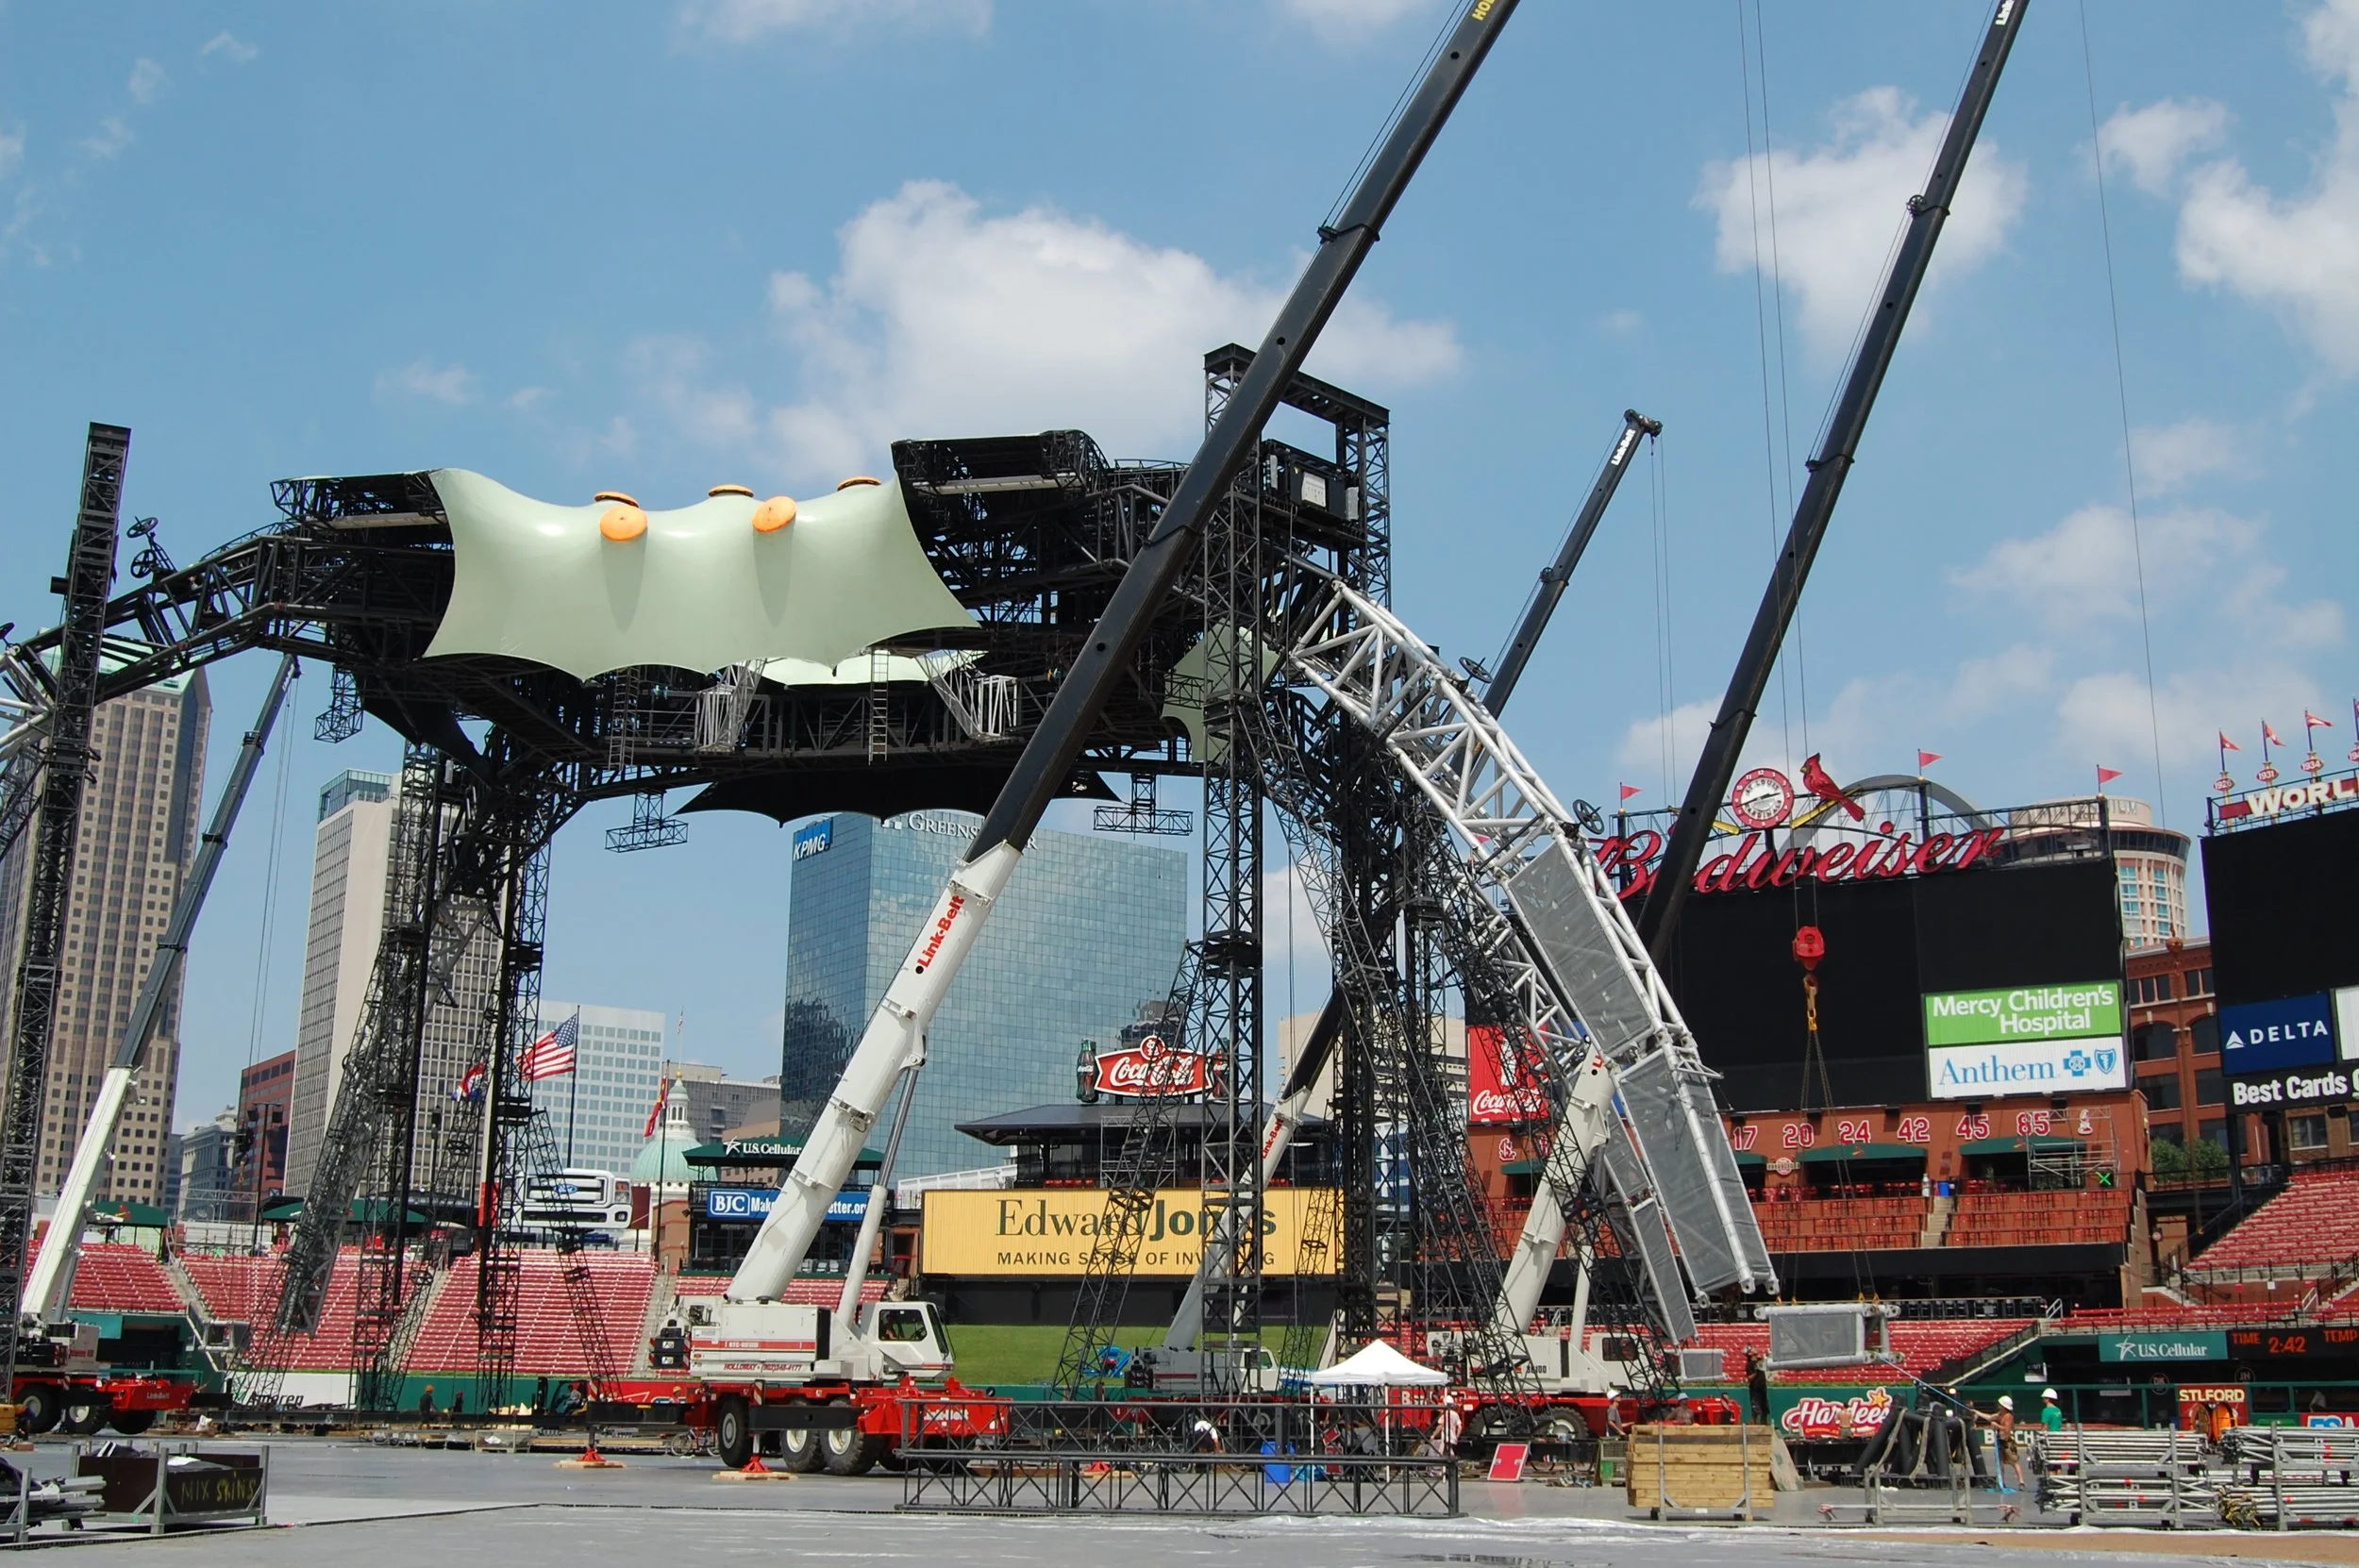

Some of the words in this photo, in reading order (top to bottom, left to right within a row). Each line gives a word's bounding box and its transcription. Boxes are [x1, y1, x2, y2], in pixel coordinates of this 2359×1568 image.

[2258, 769, 2276, 781] 1931
[2302, 759, 2321, 772] 1934
[2247, 774, 2359, 818] WORL
[793, 832, 827, 861] KPMG
[1589, 821, 2004, 900] Bdweiser
[917, 894, 965, 968] Link-Belt
[1932, 995, 2002, 1018] Mercy
[2007, 985, 2115, 1012] Children's
[1999, 1008, 2092, 1036] Hospital
[2250, 1019, 2329, 1044] DELTA
[1939, 1055, 2055, 1085] Anthem
[2233, 1079, 2283, 1106] Best
[2286, 1071, 2349, 1099] Cards
[1782, 1123, 1815, 1149] 20
[1838, 1120, 1872, 1144] 24
[1897, 1116, 1932, 1143] 42
[1955, 1113, 1990, 1141] 45
[2016, 1109, 2051, 1138] 85
[760, 1143, 802, 1156] Cellular
[1733, 1125, 1758, 1151] 17
[714, 1193, 745, 1213] BJC
[1149, 1199, 1277, 1242] Jons
[997, 1251, 1070, 1265] MAKING
[1146, 1251, 1169, 1265] OF
[2232, 1331, 2262, 1345] TIME
[2268, 1336, 2306, 1354] 2:42
[2323, 1328, 2359, 1343] TEMP
[2158, 1343, 2208, 1358] Cellular
